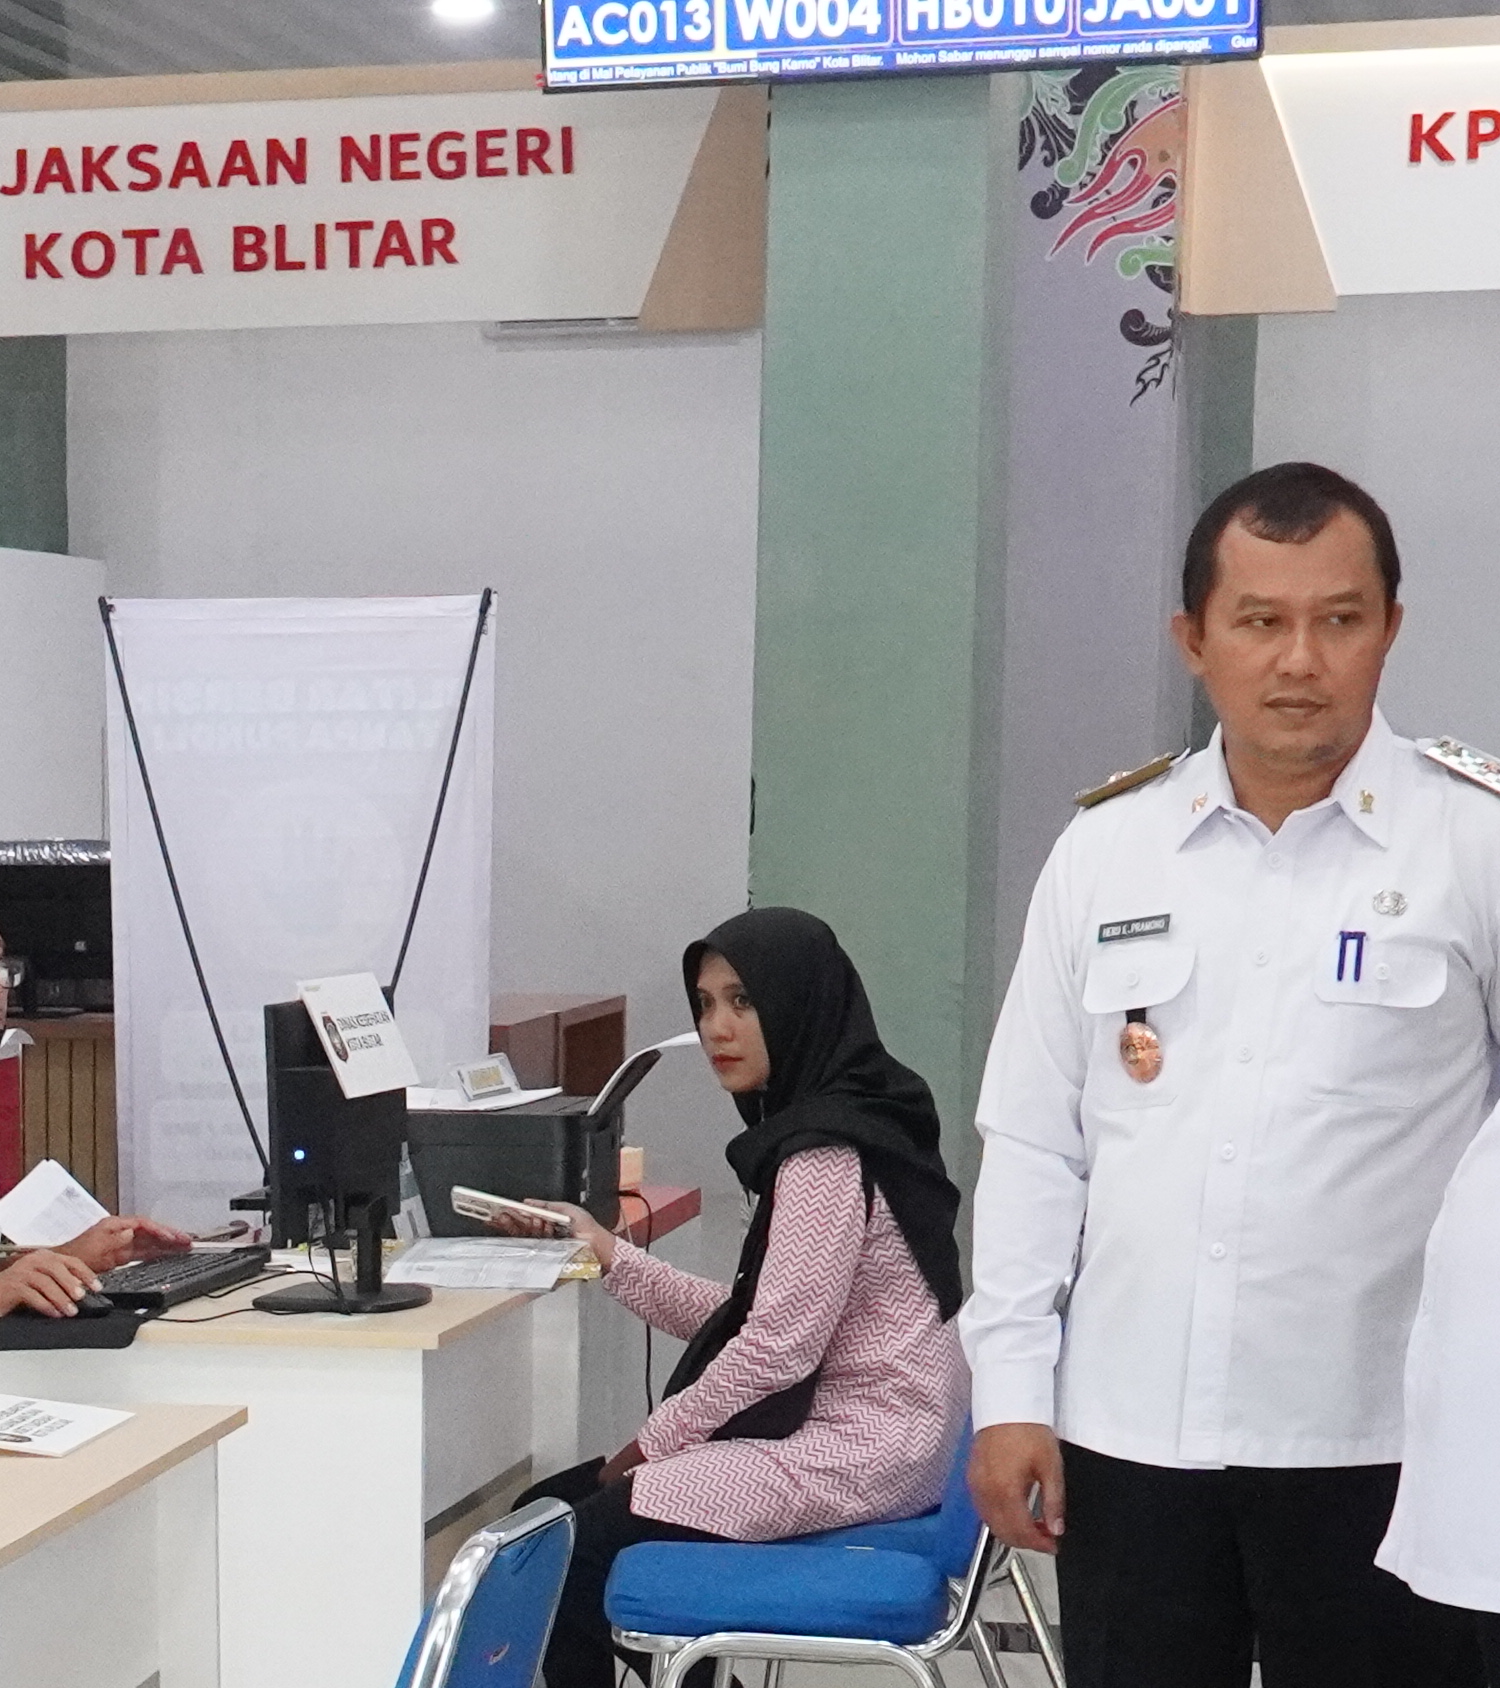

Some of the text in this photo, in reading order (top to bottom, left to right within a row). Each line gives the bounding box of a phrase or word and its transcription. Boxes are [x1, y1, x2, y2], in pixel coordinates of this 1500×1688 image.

[557, 0, 712, 46] AC013
[734, 0, 882, 40] W004
[580, 66, 590, 81] di
[593, 64, 613, 80] Mal
[615, 63, 675, 80] Pelayanan
[677, 60, 713, 76] Publik
[751, 57, 779, 75] Bung
[823, 54, 849, 69] Kota
[896, 51, 936, 65] Mohon
[938, 49, 973, 63] Sabar
[975, 46, 1036, 63] menunggu
[1038, 43, 1081, 60] sampai
[1083, 42, 1121, 56] nomor
[1123, 39, 1152, 54] anda
[340, 127, 573, 183] NEGERI
[25, 217, 457, 279] KOTA BLITAR
